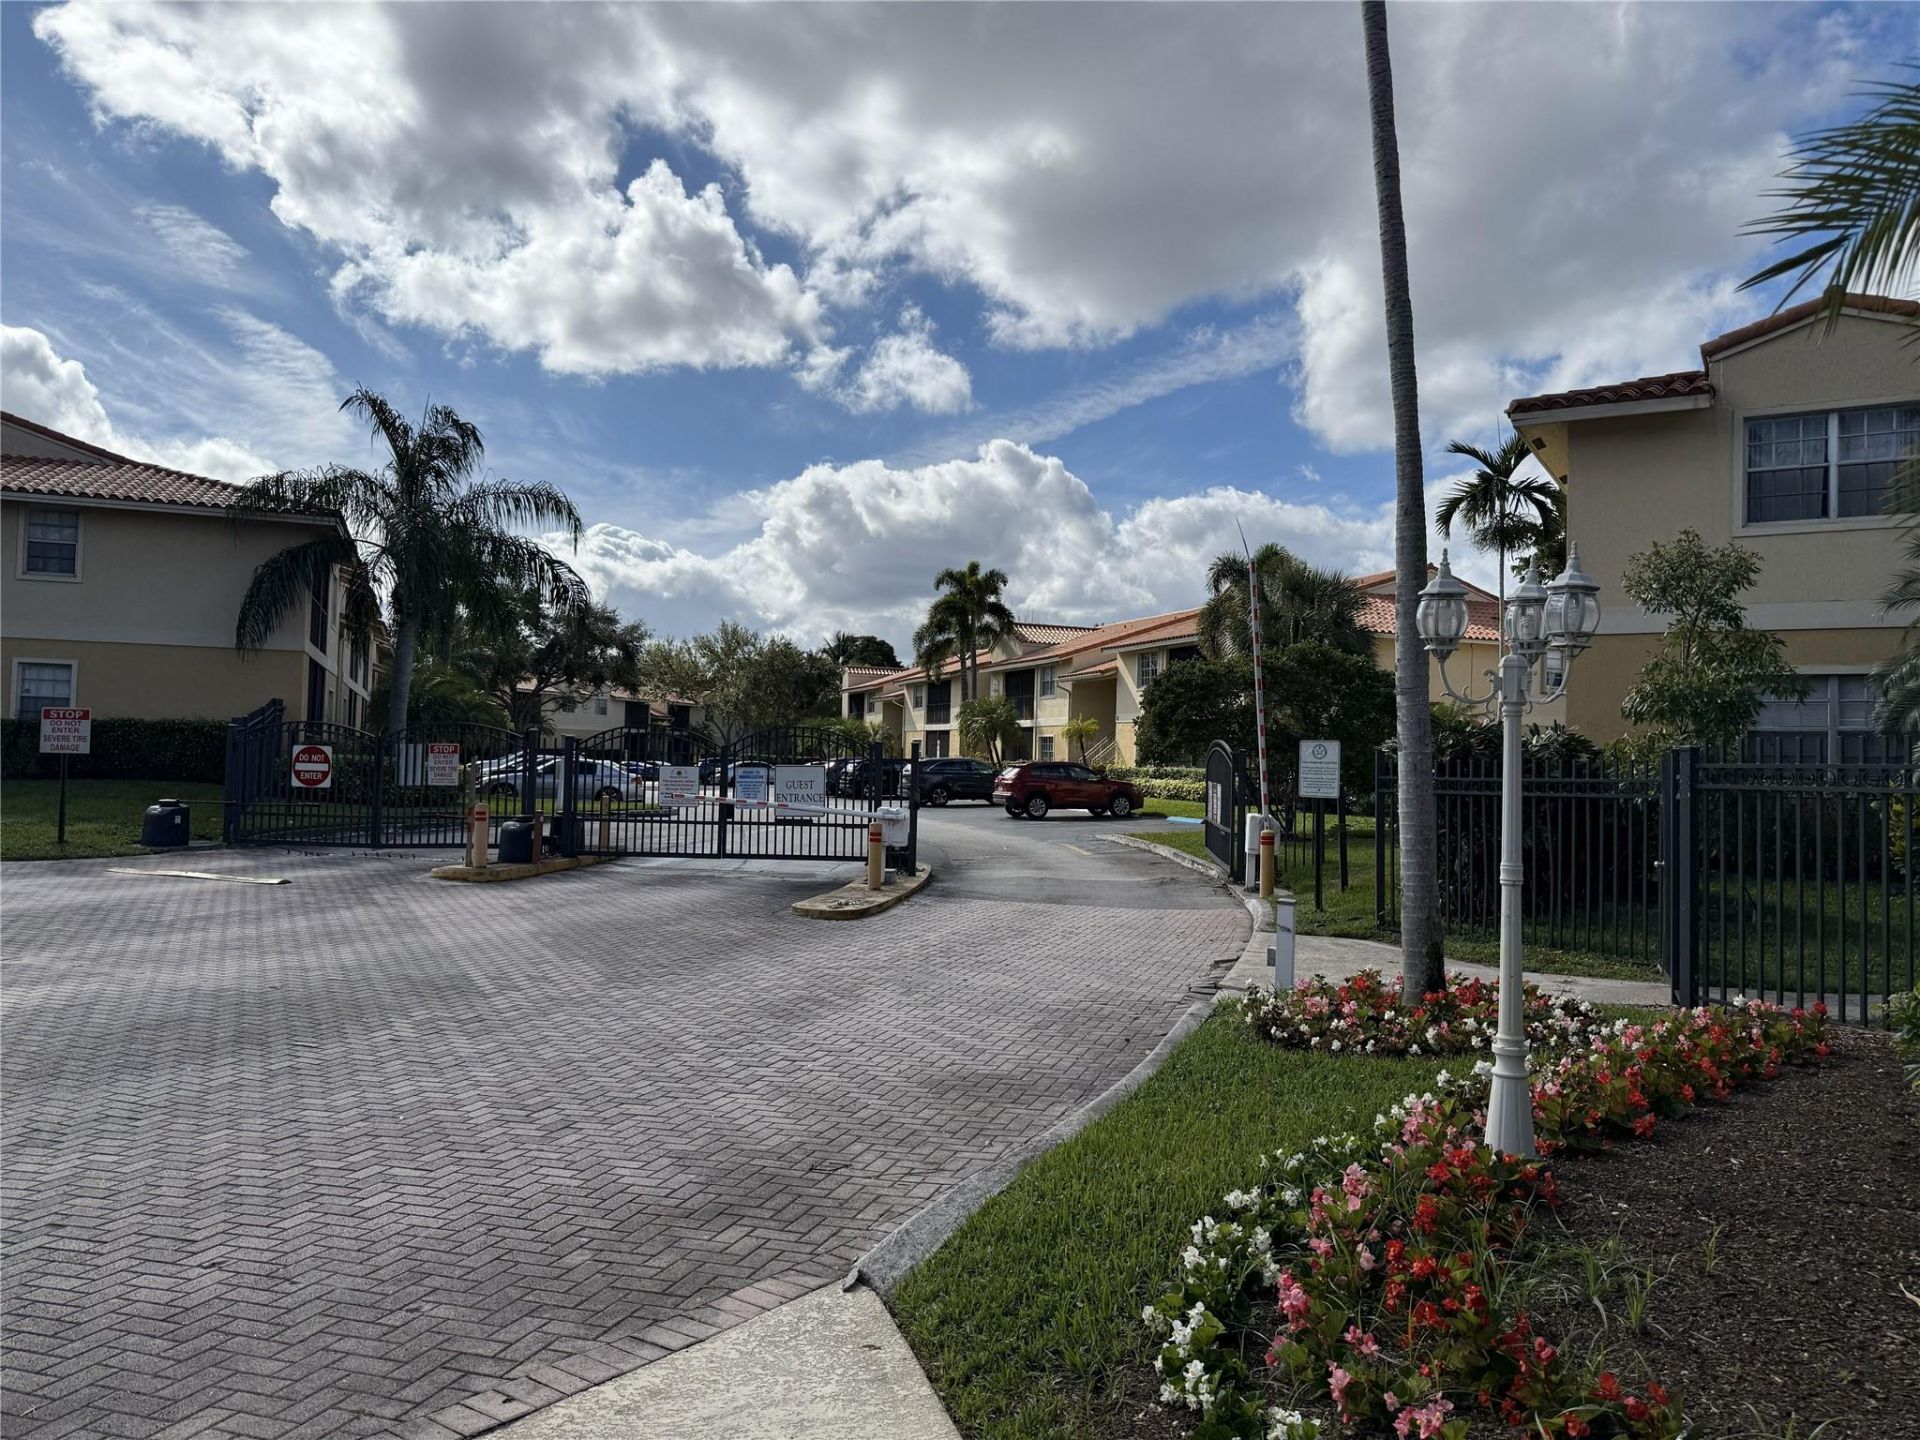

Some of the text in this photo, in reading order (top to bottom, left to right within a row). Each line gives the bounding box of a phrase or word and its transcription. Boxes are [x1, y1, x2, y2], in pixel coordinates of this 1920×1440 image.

[49, 710, 84, 719] STOP
[433, 745, 455, 753] STOP
[311, 754, 325, 762] NOT
[300, 771, 322, 779] ENTER
[786, 780, 815, 790] GUEST
[776, 793, 824, 803] ENTRANCE
